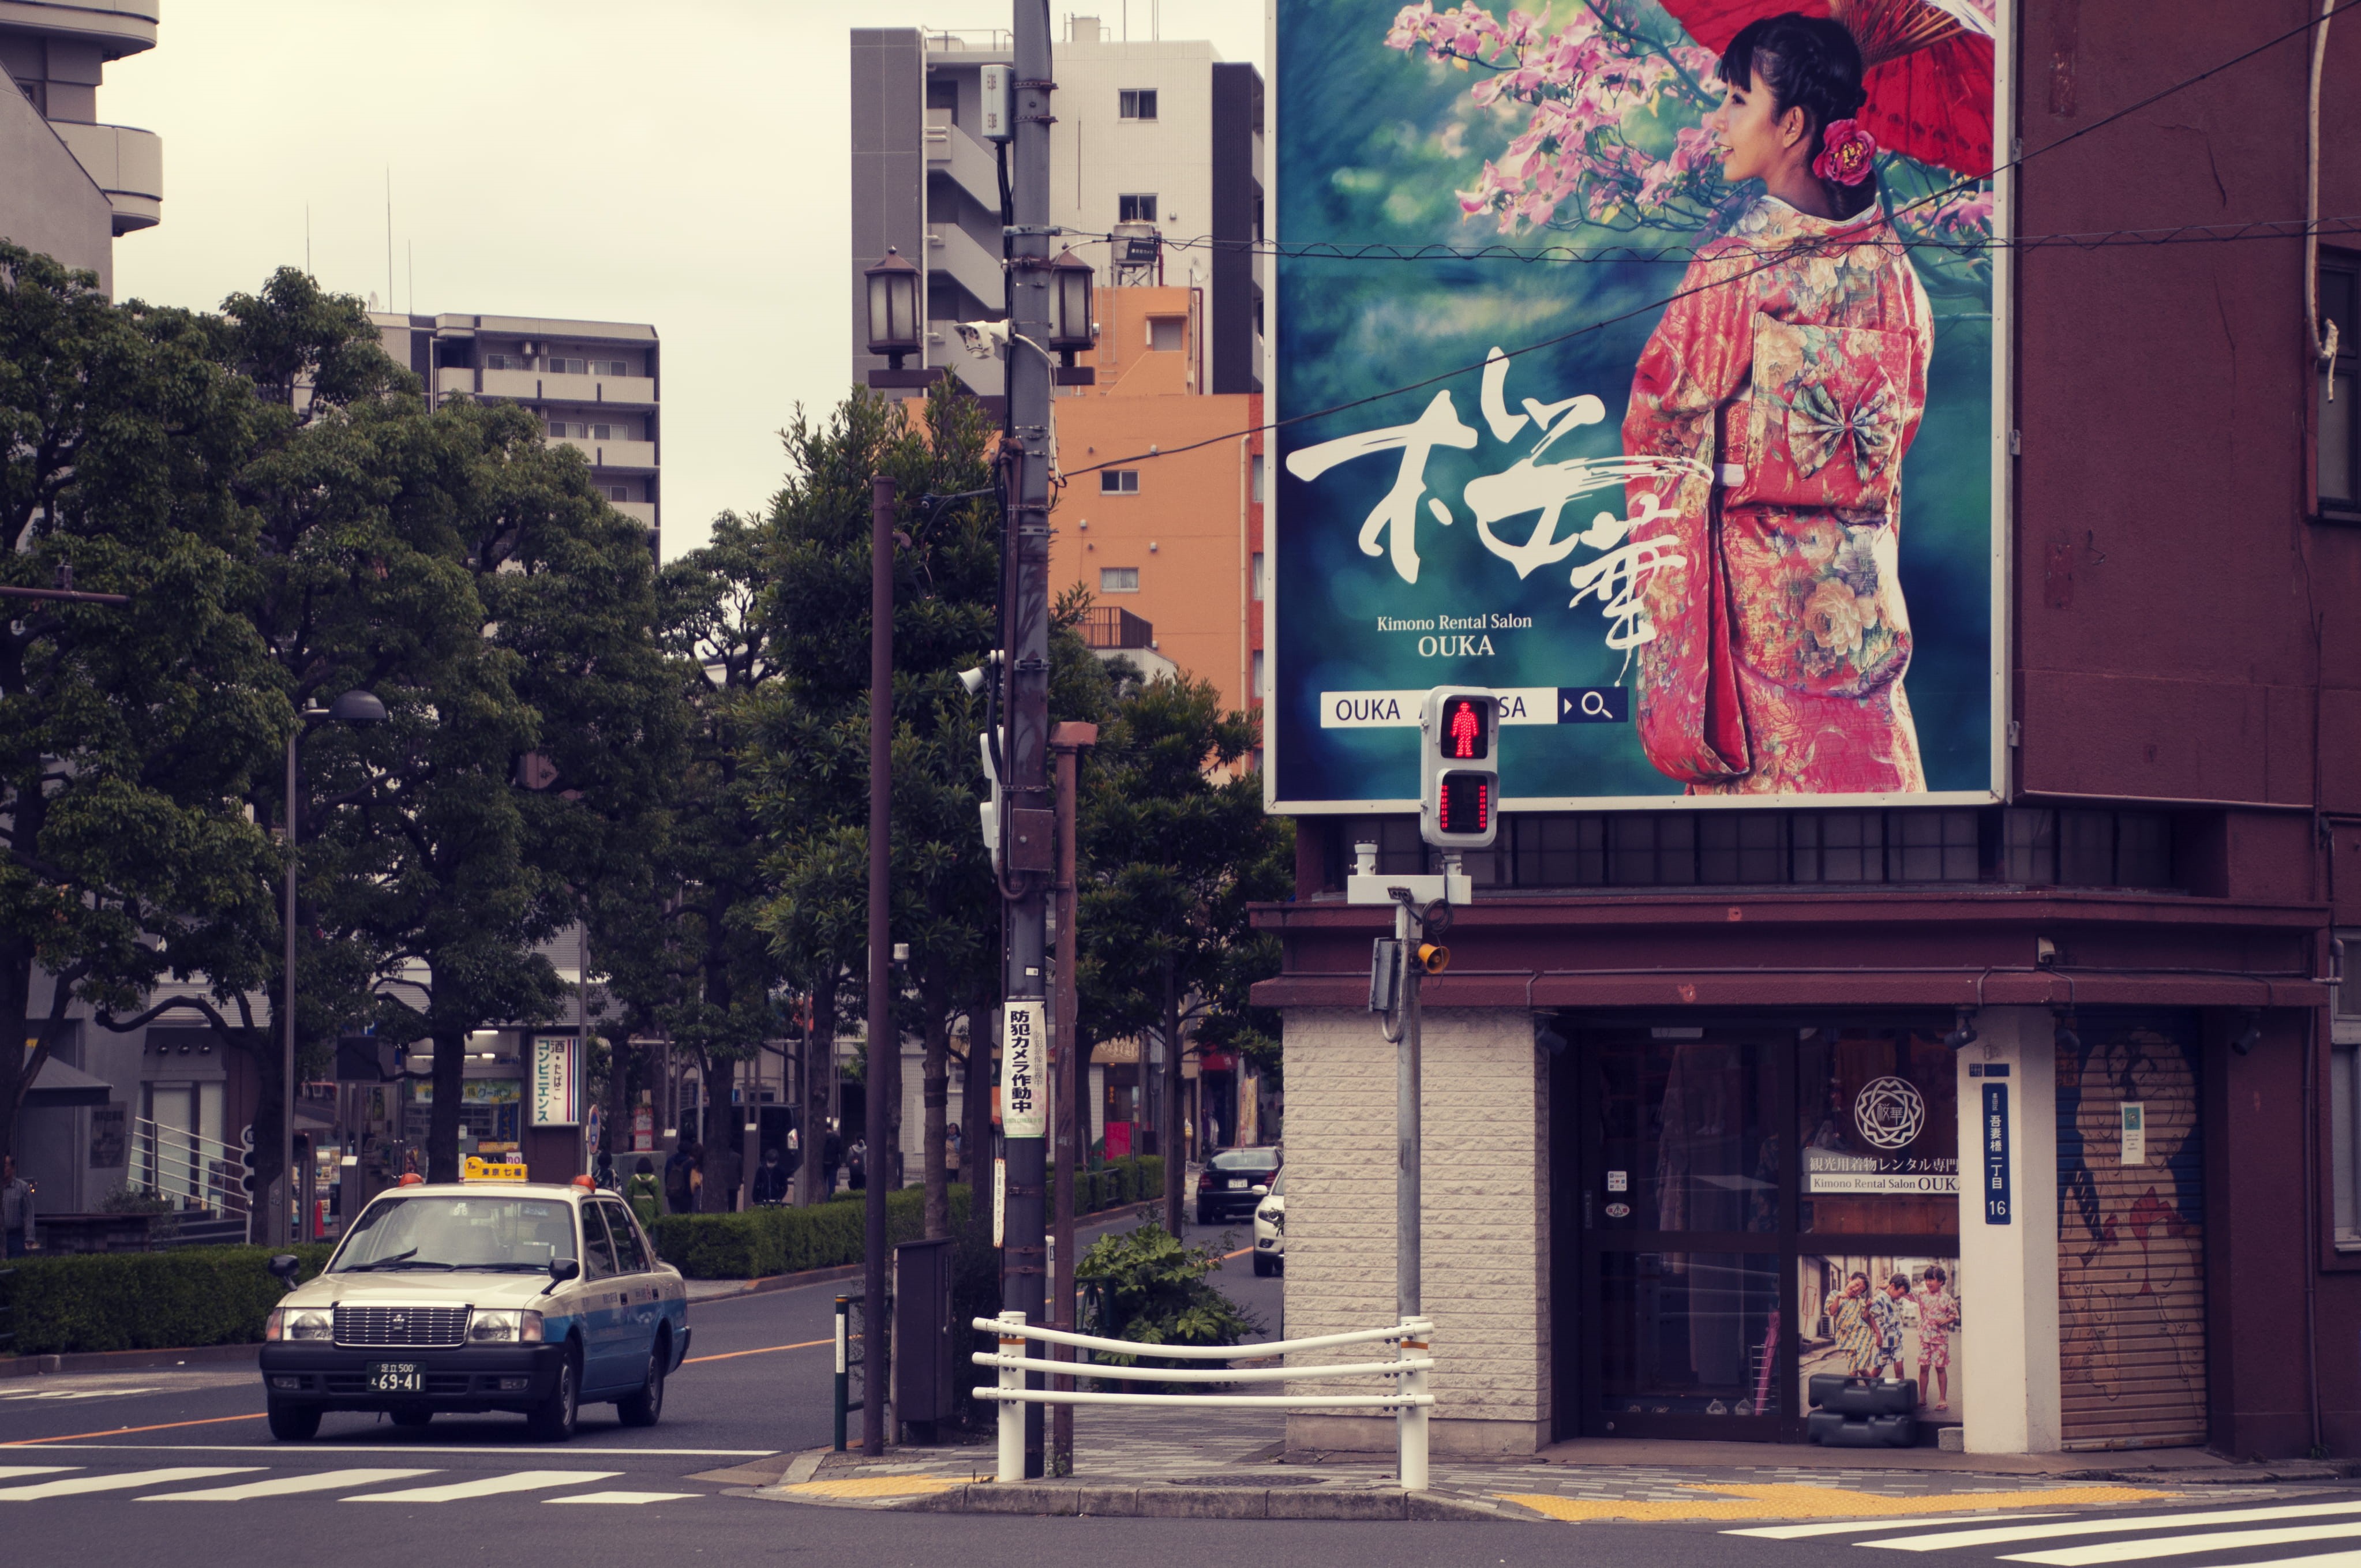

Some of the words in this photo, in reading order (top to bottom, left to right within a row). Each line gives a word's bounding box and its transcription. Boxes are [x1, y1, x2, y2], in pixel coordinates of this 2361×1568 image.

[1377, 616, 1434, 631] Kimono
[1439, 614, 1487, 630] Rental
[1491, 613, 1532, 628] Salon
[1418, 635, 1496, 657] OUKA
[1336, 699, 1400, 721] OUKA
[550, 1040, 565, 1100] 酒・たばこ
[1010, 1010, 1032, 1113] 防犯カメラ作動中
[538, 1040, 550, 1122] コンビニエンス
[1990, 1115, 2003, 1190] 吾妻橋一丁目
[1809, 1157, 1959, 1172] 観光用着物レンタル専門
[1814, 1179, 1852, 1188] Kimono
[1854, 1179, 1886, 1188] Rental
[1888, 1179, 1915, 1188] Salon
[1918, 1177, 1959, 1191] OUK
[1989, 1201, 2006, 1216] 16
[379, 1374, 420, 1389] 69-41
